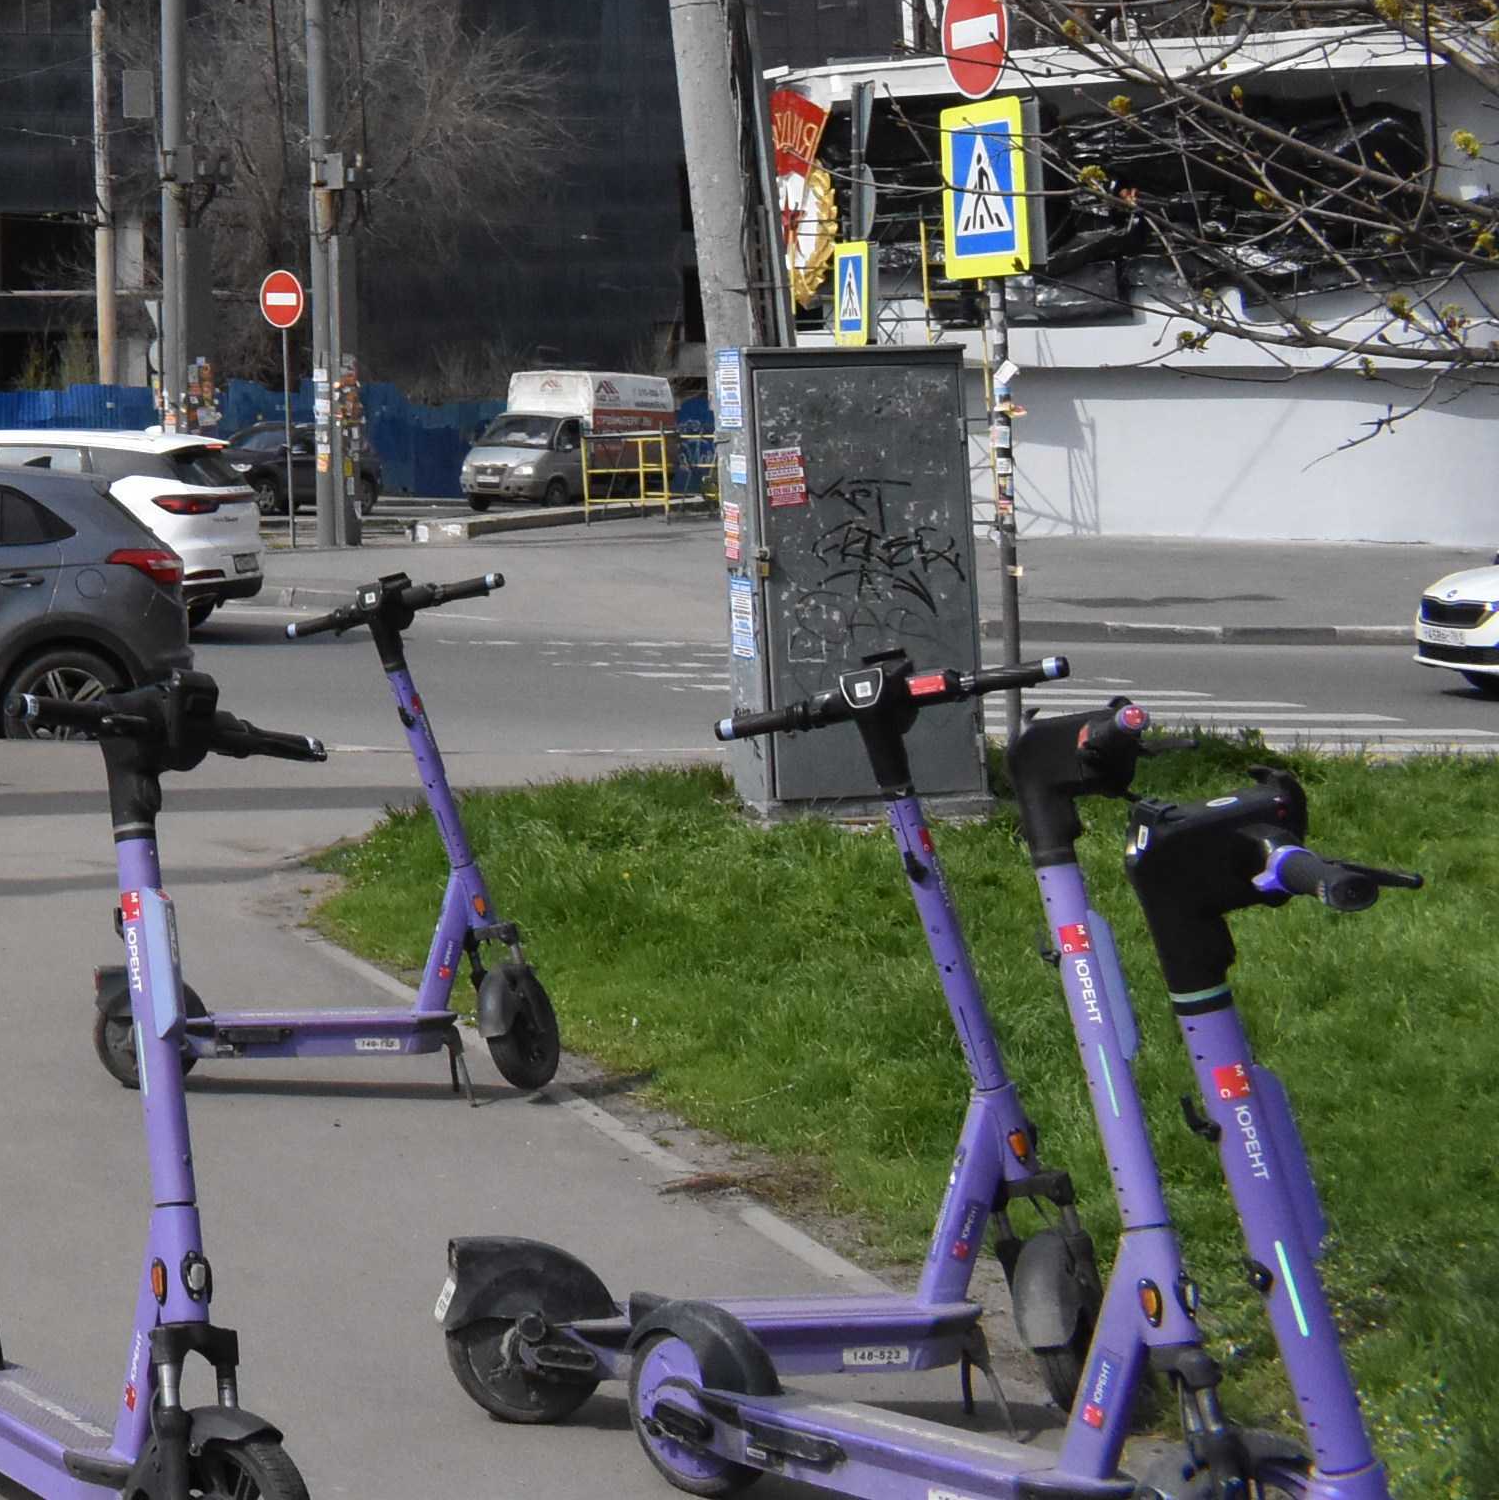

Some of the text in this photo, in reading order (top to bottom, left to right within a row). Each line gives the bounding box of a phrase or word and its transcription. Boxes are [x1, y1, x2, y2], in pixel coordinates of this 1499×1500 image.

[127, 926, 143, 992] ЮРЕНТ
[1074, 958, 1103, 1024] ЮРЕНТ
[1234, 1105, 1271, 1180] ЮРЕНТ
[1093, 1360, 1112, 1404] ЮРЕНТ
